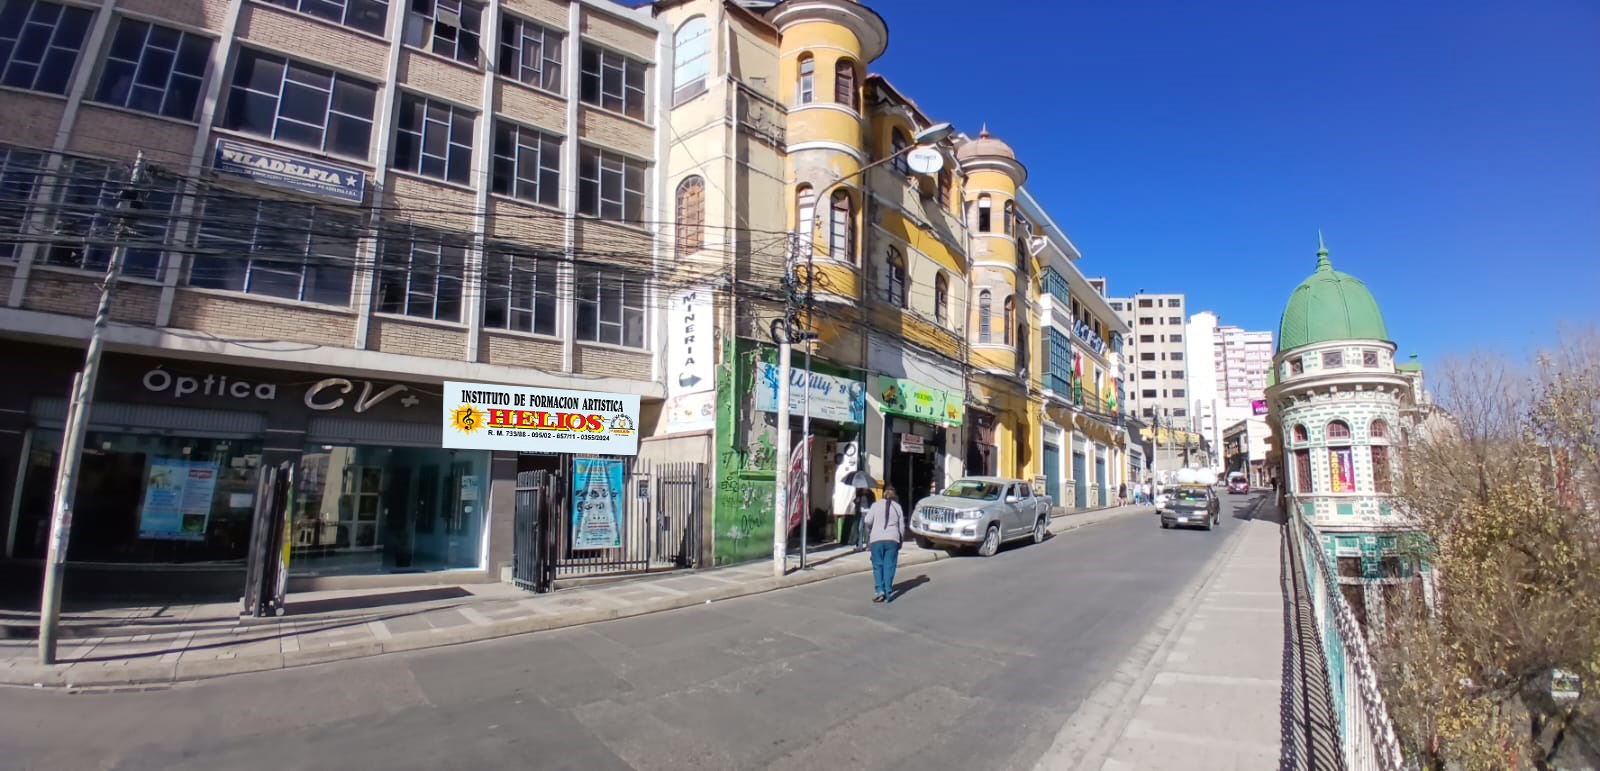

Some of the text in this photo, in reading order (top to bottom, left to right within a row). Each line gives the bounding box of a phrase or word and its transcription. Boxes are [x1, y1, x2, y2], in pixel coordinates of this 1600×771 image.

[221, 149, 341, 185] FILADELFIA
[682, 292, 697, 367] MINERIA
[143, 364, 277, 400] Óptica
[461, 389, 624, 413] INSTITUTO DE FORMACION ARTISTICA
[487, 408, 604, 433] HELIOS
